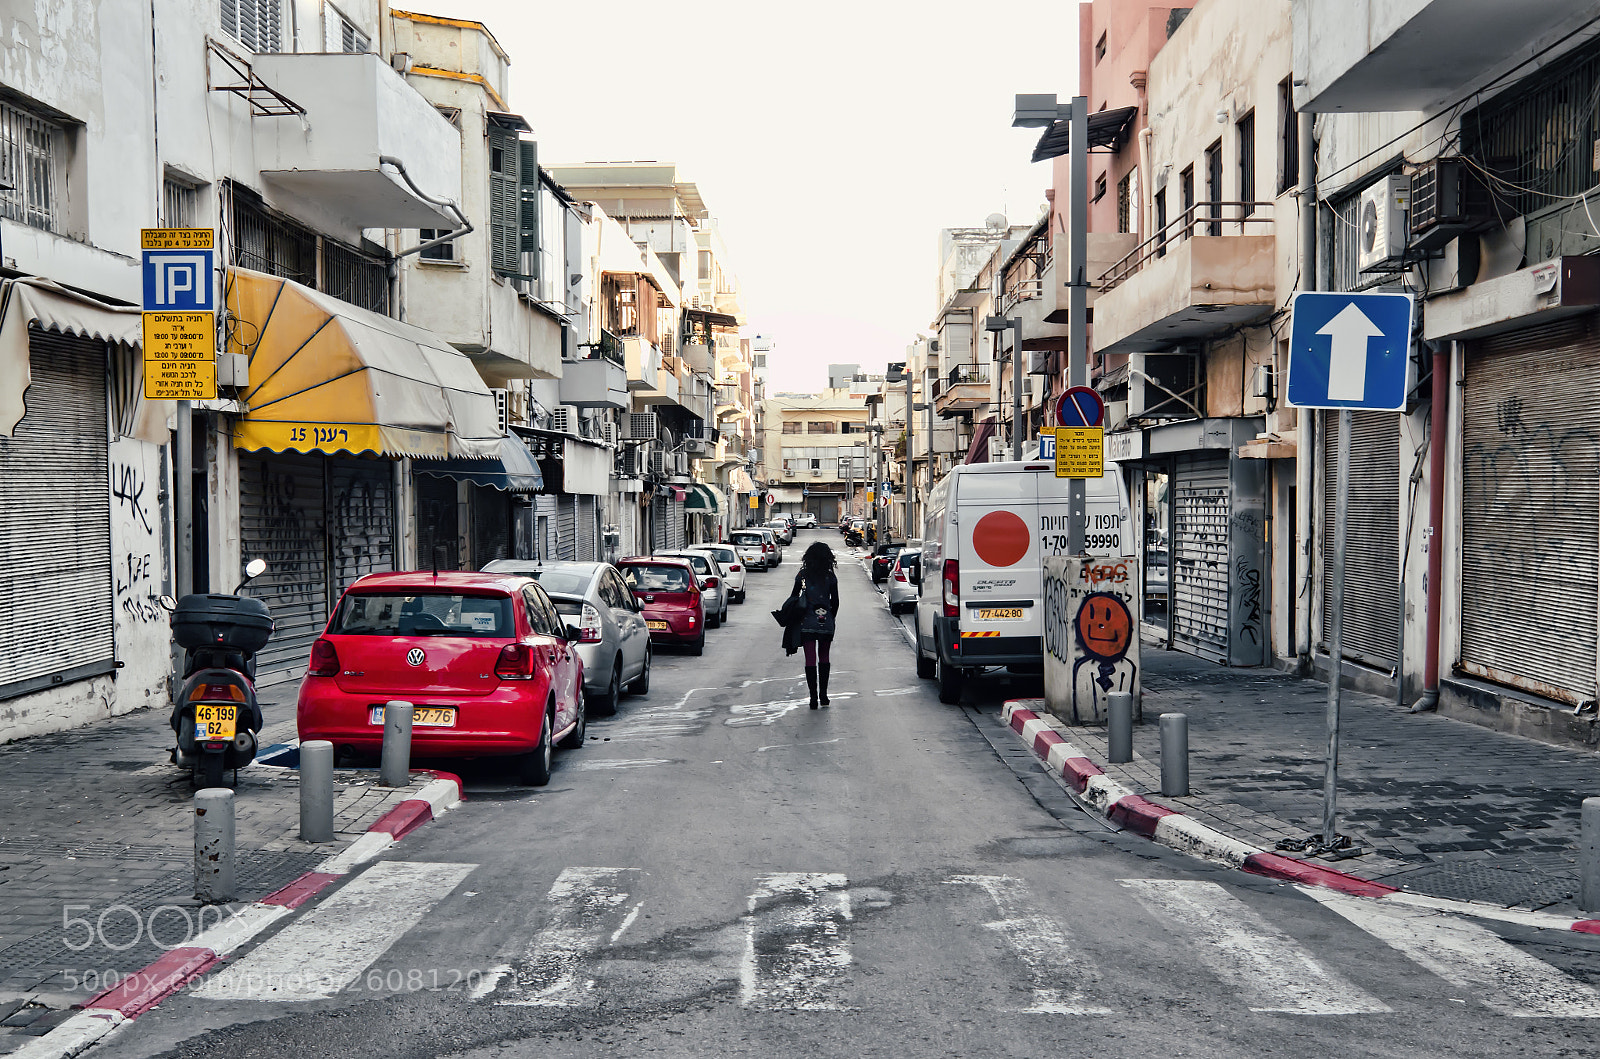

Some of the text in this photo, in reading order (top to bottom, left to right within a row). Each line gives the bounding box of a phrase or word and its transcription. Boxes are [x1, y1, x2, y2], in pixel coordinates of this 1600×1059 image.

[145, 230, 211, 239] החניה בצד זה מוגבלת
[146, 239, 162, 247] בלבד
[164, 240, 173, 248] טון
[193, 239, 210, 247] לרכב
[154, 314, 183, 322] בתשלום
[170, 333, 178, 341] עד
[170, 352, 178, 360] עד
[289, 427, 348, 447] רענן 15
[1095, 514, 1120, 530] תפוז
[208, 721, 222, 735] 62
